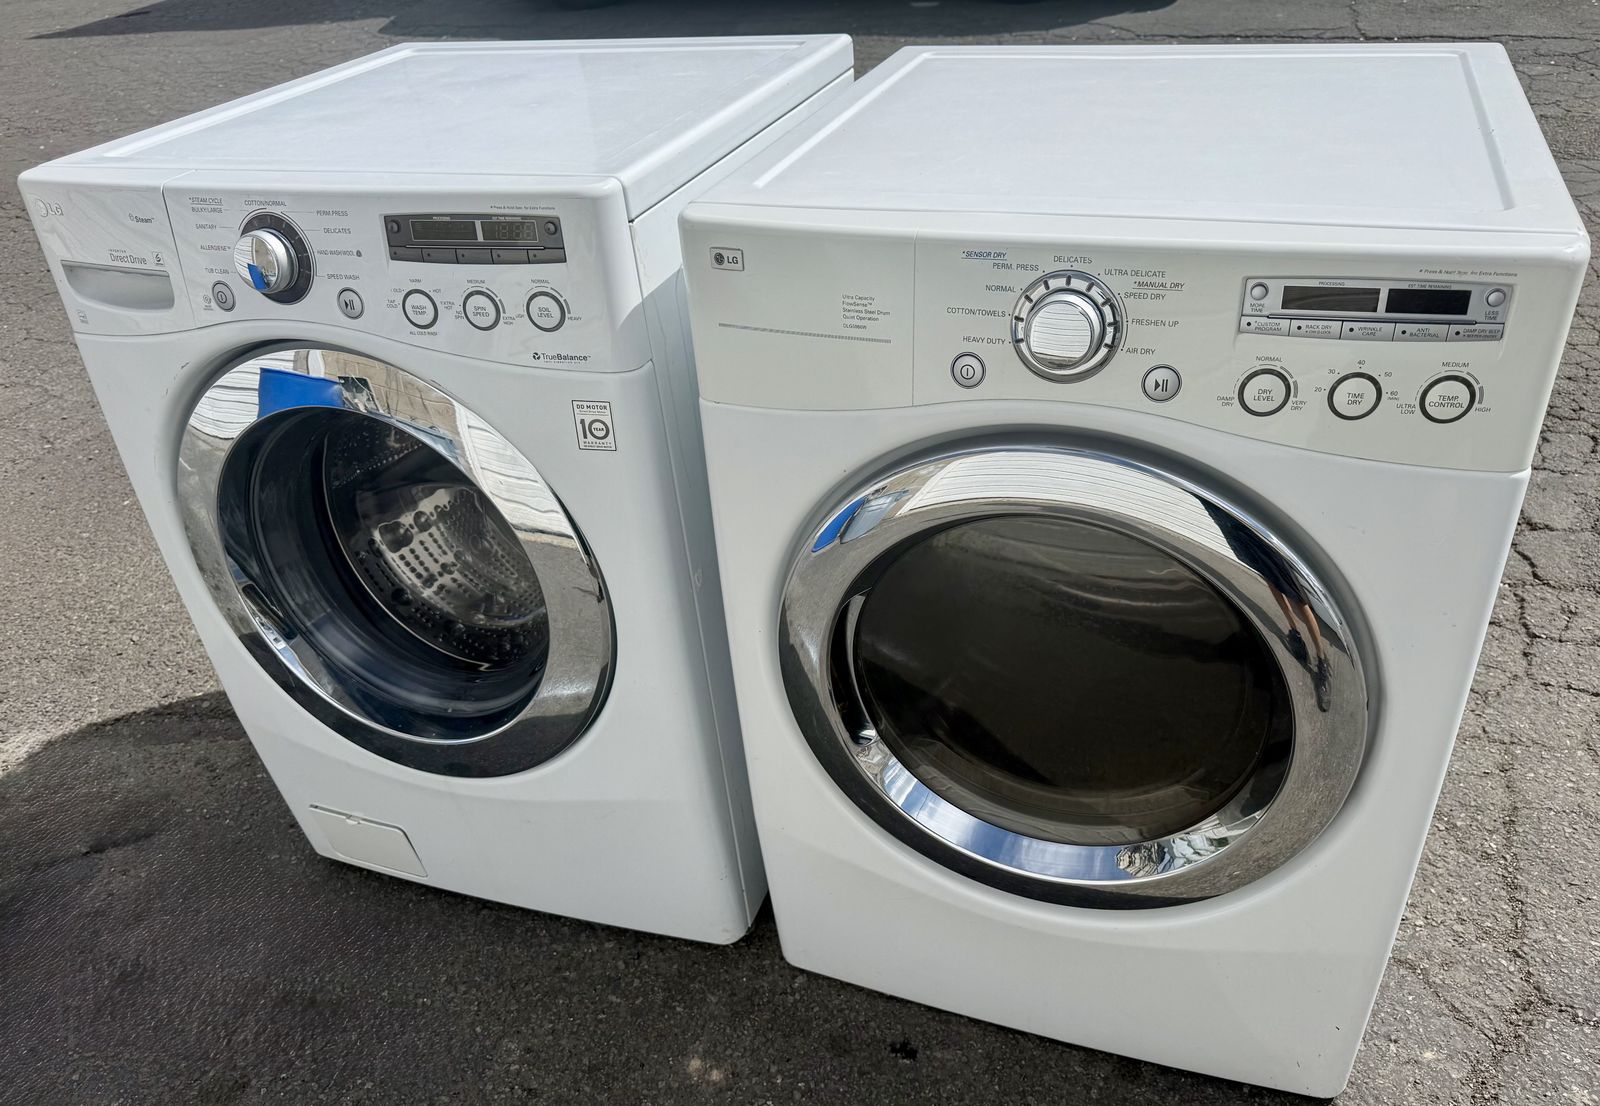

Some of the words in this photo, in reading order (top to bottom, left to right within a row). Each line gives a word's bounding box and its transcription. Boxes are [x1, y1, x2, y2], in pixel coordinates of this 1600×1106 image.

[47, 202, 64, 216] LG
[727, 256, 738, 264] LG
[1053, 256, 1092, 264] DELICATES
[992, 262, 1013, 270] PERM.
[1016, 263, 1040, 272] PRESS
[1104, 268, 1128, 276] ULTRA
[1130, 270, 1166, 278] DELICATE
[985, 284, 1016, 292] NORMAL
[1124, 291, 1148, 300] SPEED
[1150, 292, 1166, 300] DRY
[946, 306, 1006, 318] COTTON/TOWELS
[1131, 318, 1166, 326] FRESHEN
[962, 335, 986, 344] HEAVY
[986, 336, 1006, 344] DUTY
[580, 419, 609, 440] 10
